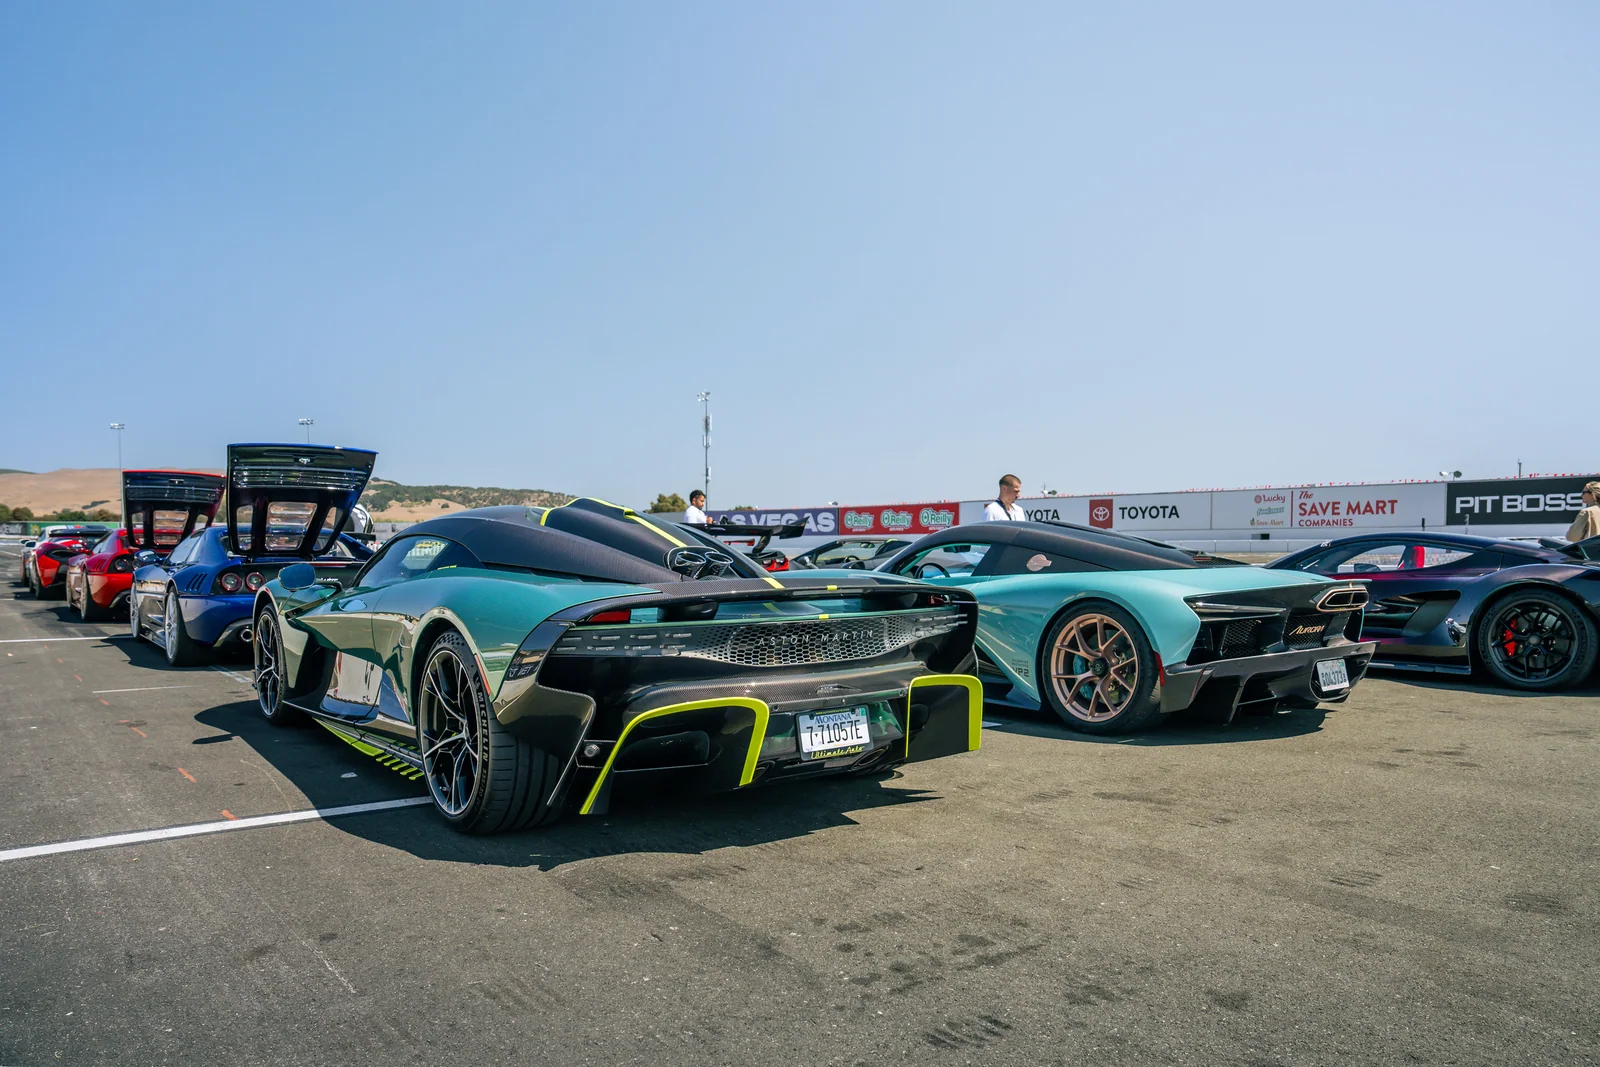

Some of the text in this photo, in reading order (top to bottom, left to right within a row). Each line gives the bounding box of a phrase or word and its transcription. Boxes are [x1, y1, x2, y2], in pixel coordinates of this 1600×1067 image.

[1262, 493, 1286, 504] Lucky
[1299, 490, 1314, 500] The
[1298, 499, 1398, 517] SAVE MART
[1455, 492, 1588, 514] PIT BOSS
[845, 512, 873, 527] O'Reilly
[882, 511, 911, 527] O'Reilly
[922, 510, 952, 526] O'Reilly
[1025, 509, 1060, 522] YOTA
[1118, 505, 1180, 520] TOYOTA
[1298, 518, 1354, 527] COMPANIES
[757, 629, 874, 647] ASTON MARTIN
[815, 713, 852, 725] MONTANA
[477, 692, 489, 762] MICHELIN
[810, 745, 865, 760] Ultimate Auto
